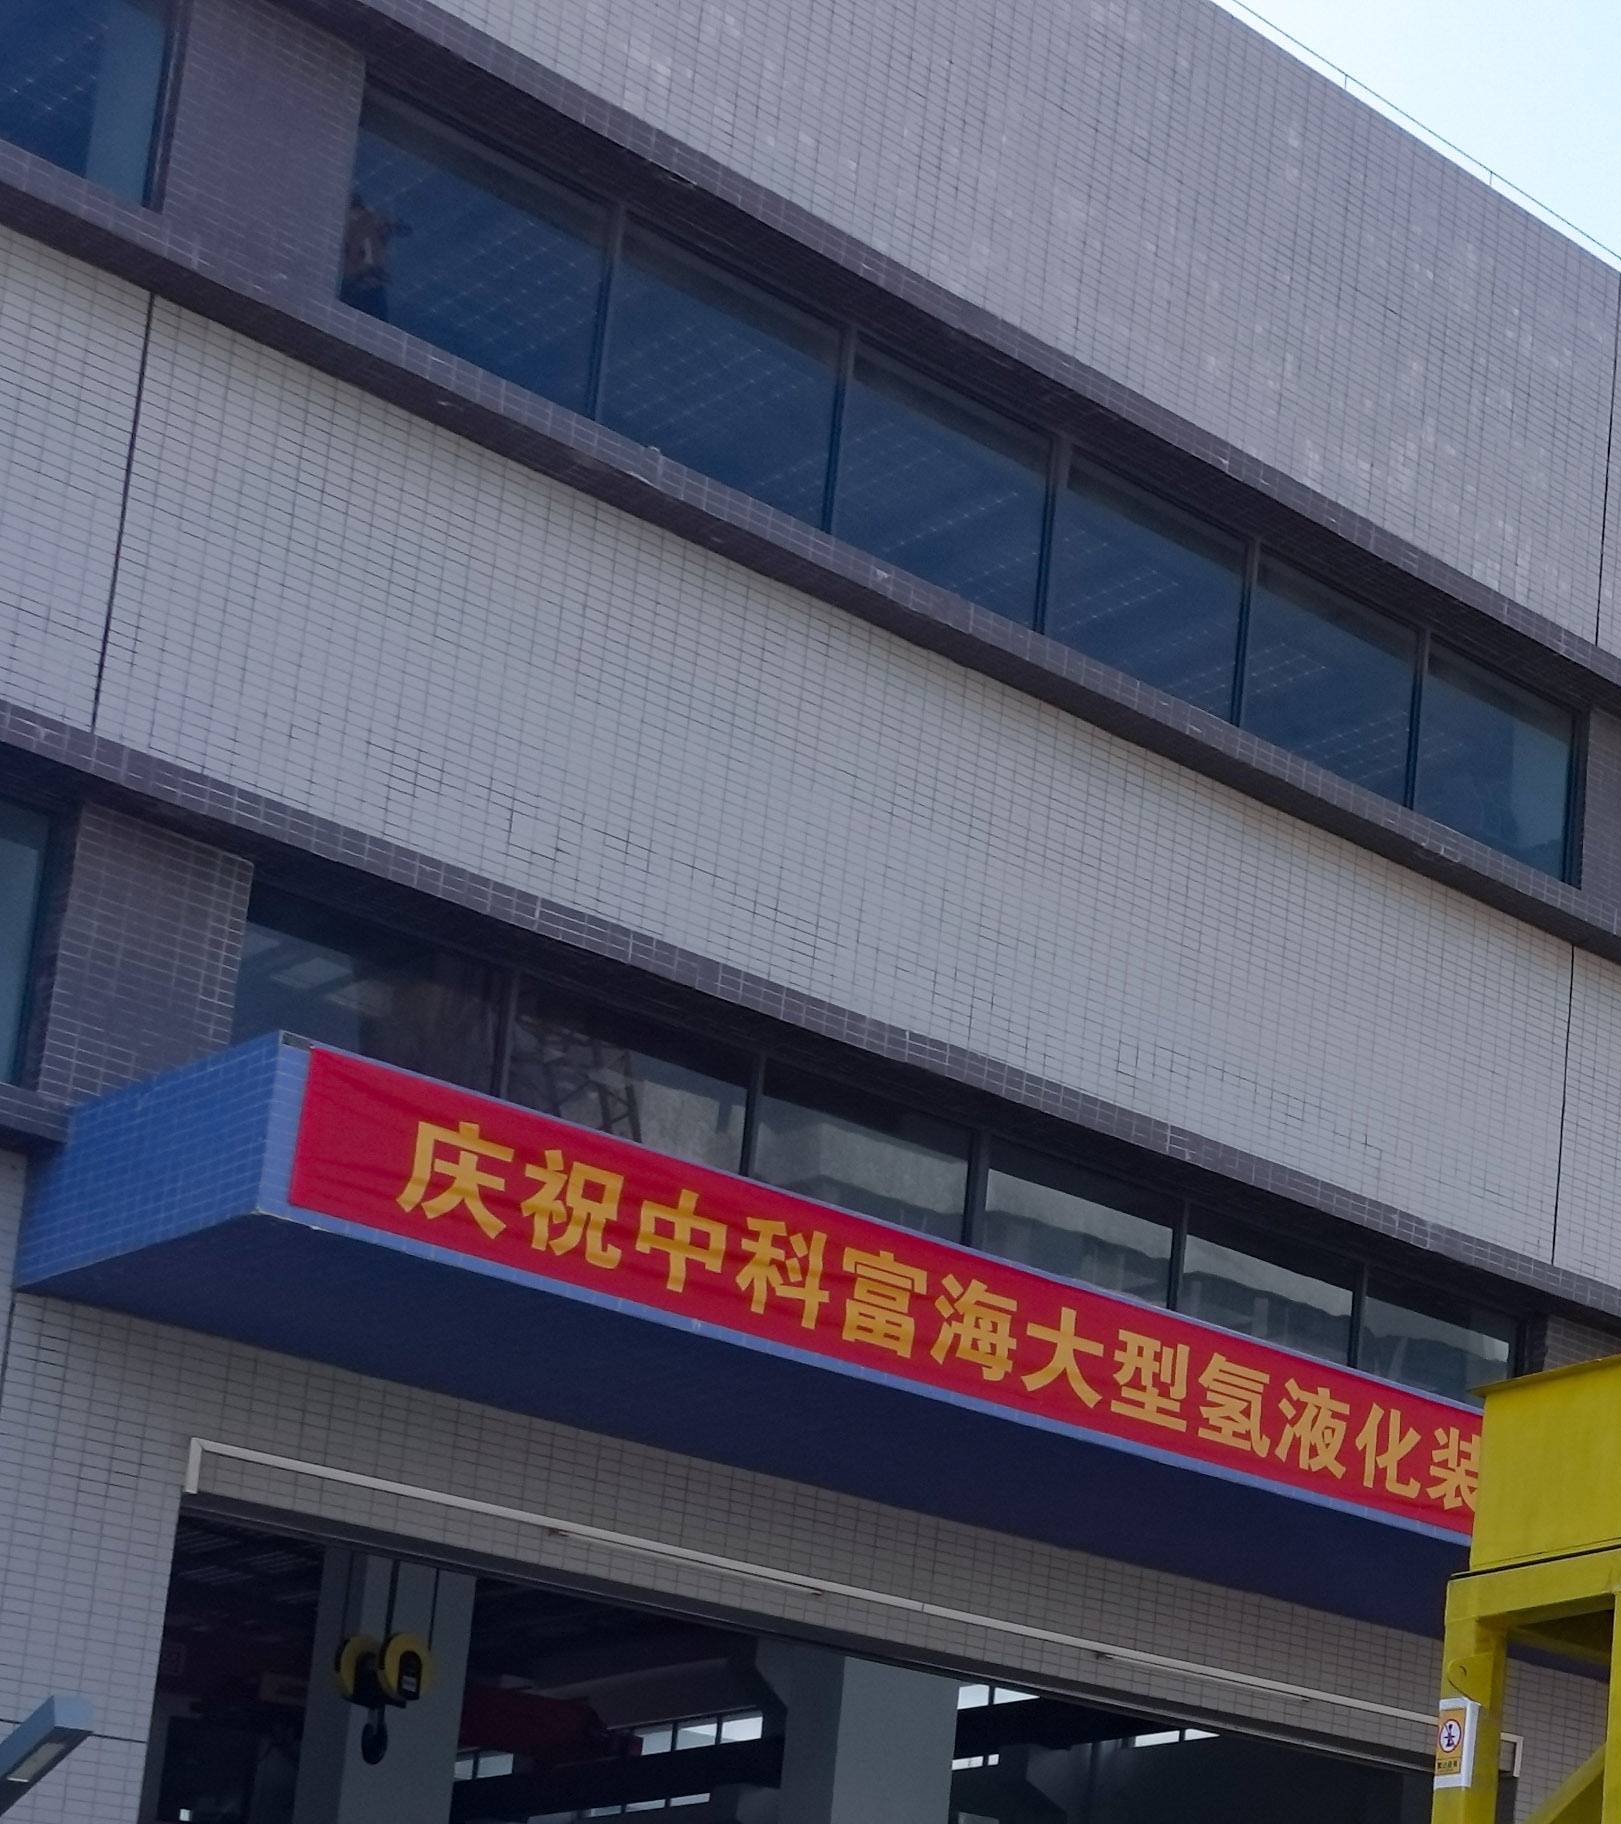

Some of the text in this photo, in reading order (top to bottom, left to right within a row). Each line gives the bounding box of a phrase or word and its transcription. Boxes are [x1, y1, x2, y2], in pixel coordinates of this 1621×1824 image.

[394, 1118, 1485, 1510] 庆祝中科富海大型氢液化装
